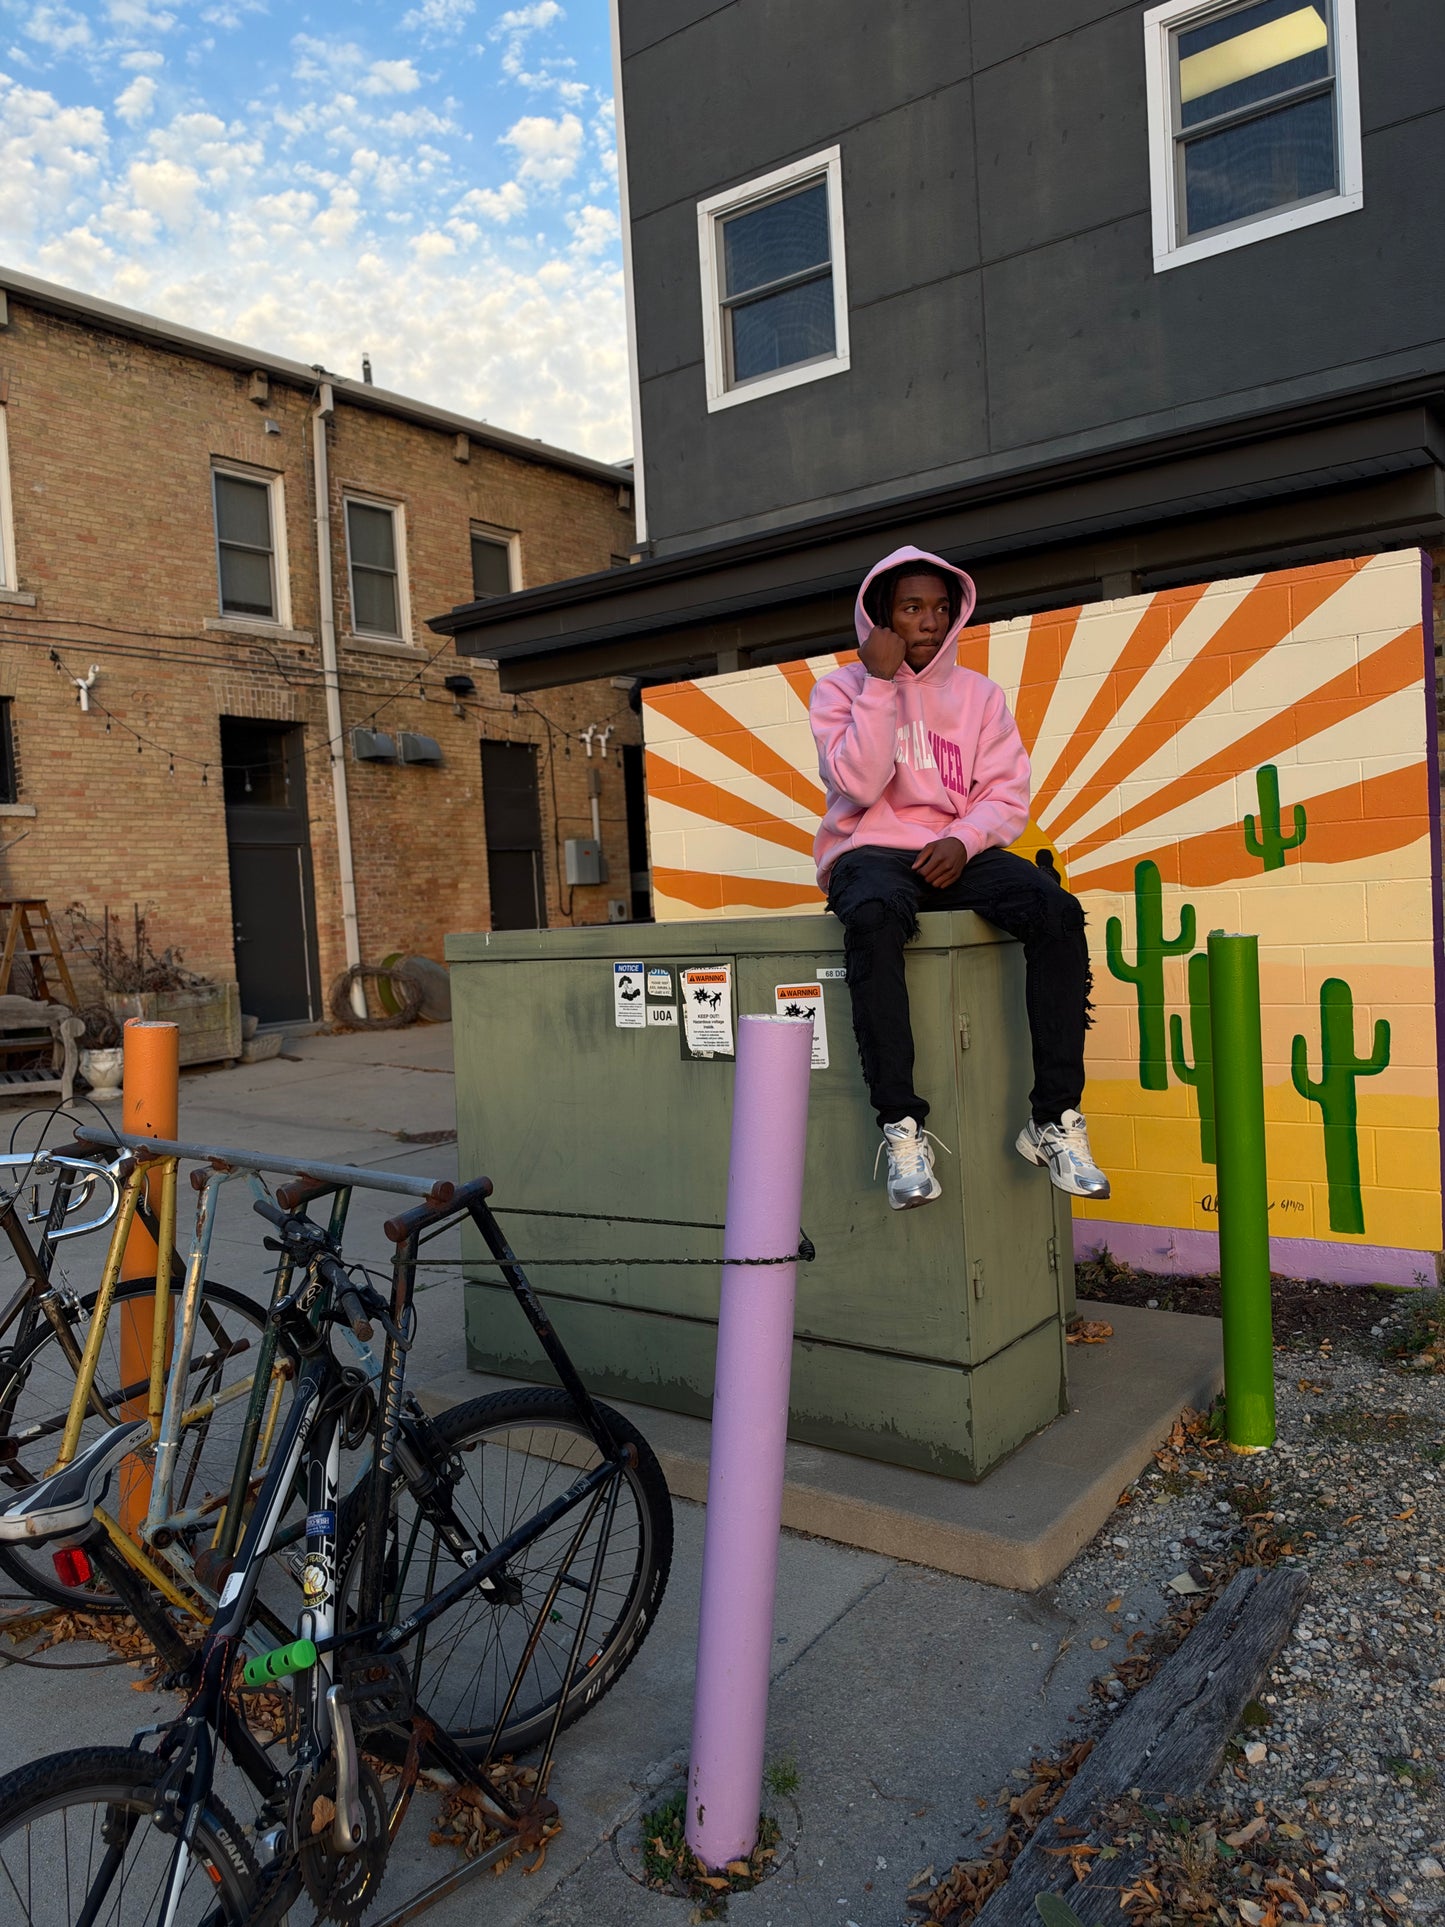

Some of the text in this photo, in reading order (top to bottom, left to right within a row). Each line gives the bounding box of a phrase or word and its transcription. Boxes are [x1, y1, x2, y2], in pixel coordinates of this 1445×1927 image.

[696, 974, 724, 982] WARNING
[825, 970, 834, 978] 68
[787, 988, 819, 997] WARNING
[653, 1010, 673, 1021] UOA
[299, 1418, 312, 1441] 820
[215, 1827, 250, 1875] GIANT
